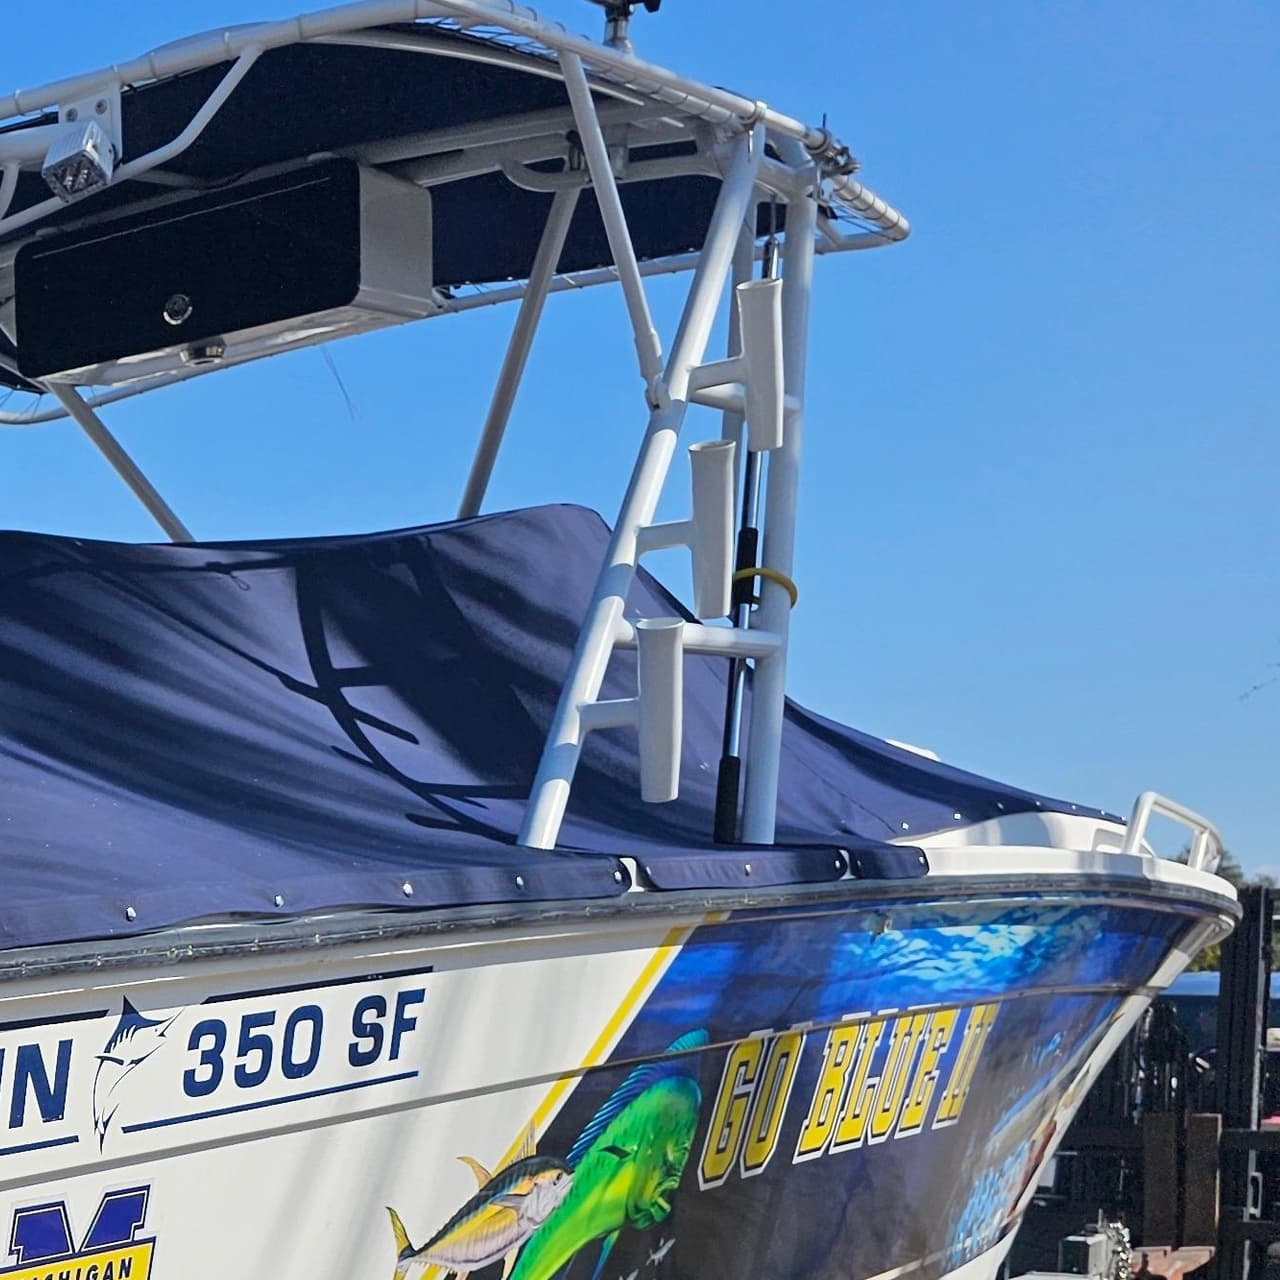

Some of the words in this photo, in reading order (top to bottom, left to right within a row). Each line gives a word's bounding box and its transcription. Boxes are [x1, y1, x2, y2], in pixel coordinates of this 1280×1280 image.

[183, 1004, 324, 1098] 350
[348, 988, 427, 1068] SF
[697, 1021, 814, 1192] GO
[792, 1003, 961, 1165] BLUE
